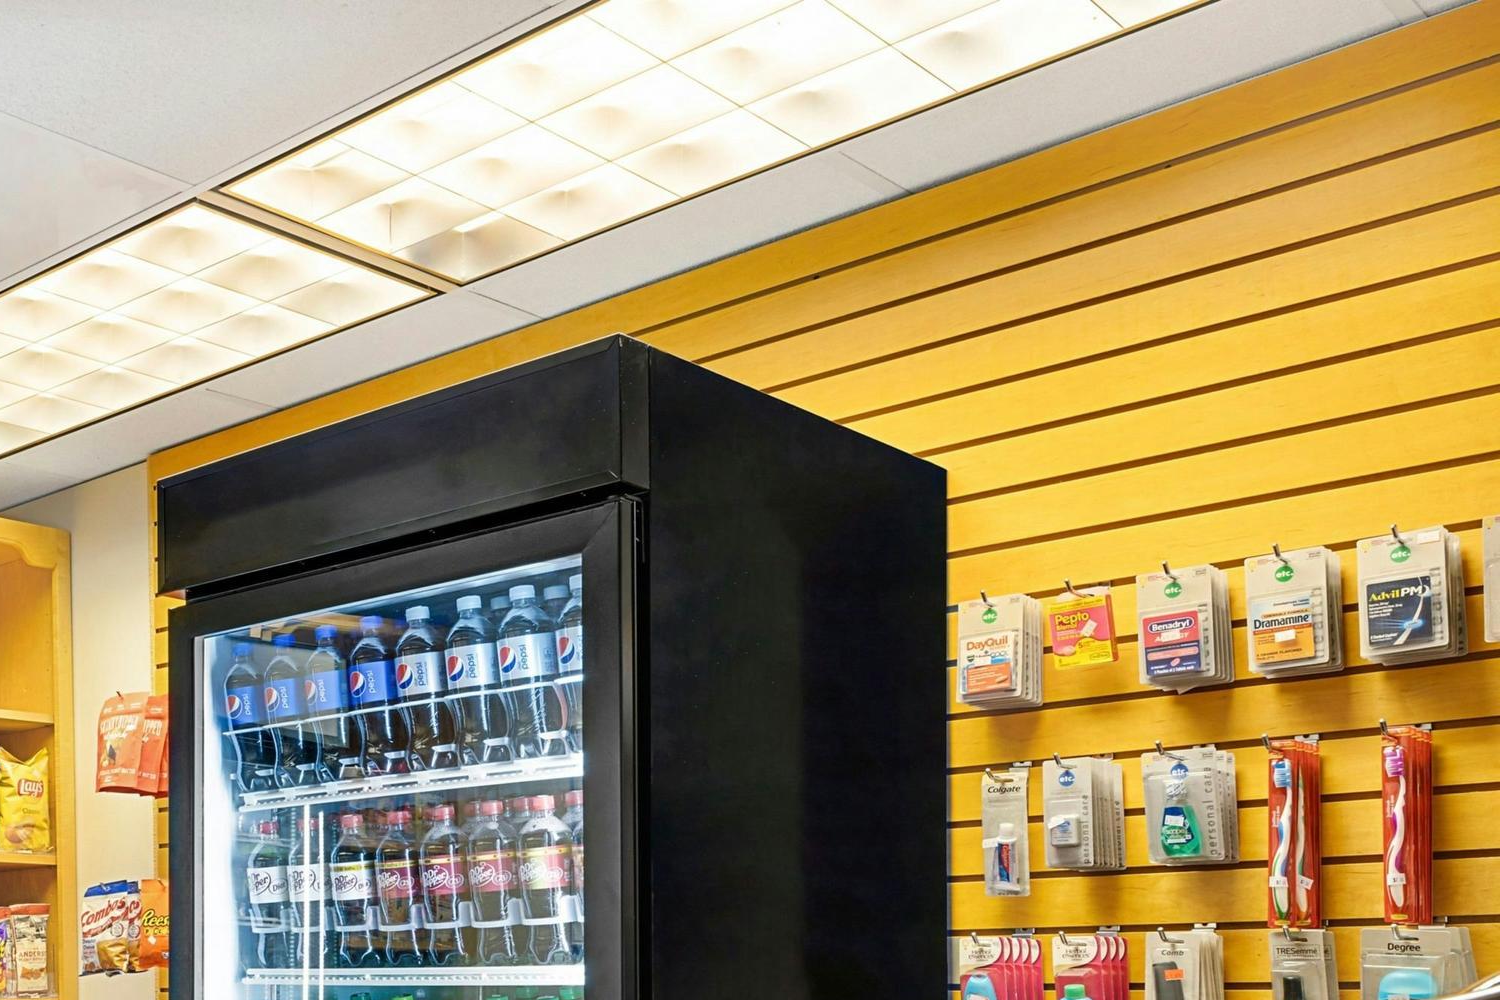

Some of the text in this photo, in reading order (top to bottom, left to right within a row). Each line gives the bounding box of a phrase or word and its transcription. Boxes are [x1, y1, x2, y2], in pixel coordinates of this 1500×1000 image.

[1390, 551, 1412, 559] etc.
[1275, 570, 1294, 578] etc.
[1165, 587, 1183, 595] etc.
[1368, 586, 1424, 602] Advil PM
[1064, 611, 1090, 626] Pepto
[1150, 618, 1190, 632] Benadryl
[1254, 613, 1310, 630] Dramamine
[966, 636, 1009, 651] DayQuil
[521, 644, 531, 670] pepsi
[467, 653, 479, 679] pepsi
[365, 669, 376, 694] pepsi
[416, 661, 428, 687] pepsi
[279, 686, 290, 710] pepsi
[317, 679, 326, 703] pepsi
[242, 693, 251, 716] pepsi
[1059, 775, 1076, 783] etc.
[1171, 767, 1189, 776] etc.
[20, 780, 44, 797] Lay's
[987, 784, 1022, 795] Colgate
[1203, 766, 1220, 857] personal care
[1082, 794, 1092, 865] personal care
[423, 869, 438, 880] Dr
[470, 865, 484, 877] Dr
[81, 904, 119, 928] Combos
[1160, 949, 1185, 957] Comb
[1275, 947, 1318, 956] TRESemmé
[1387, 942, 1421, 955] Degree
